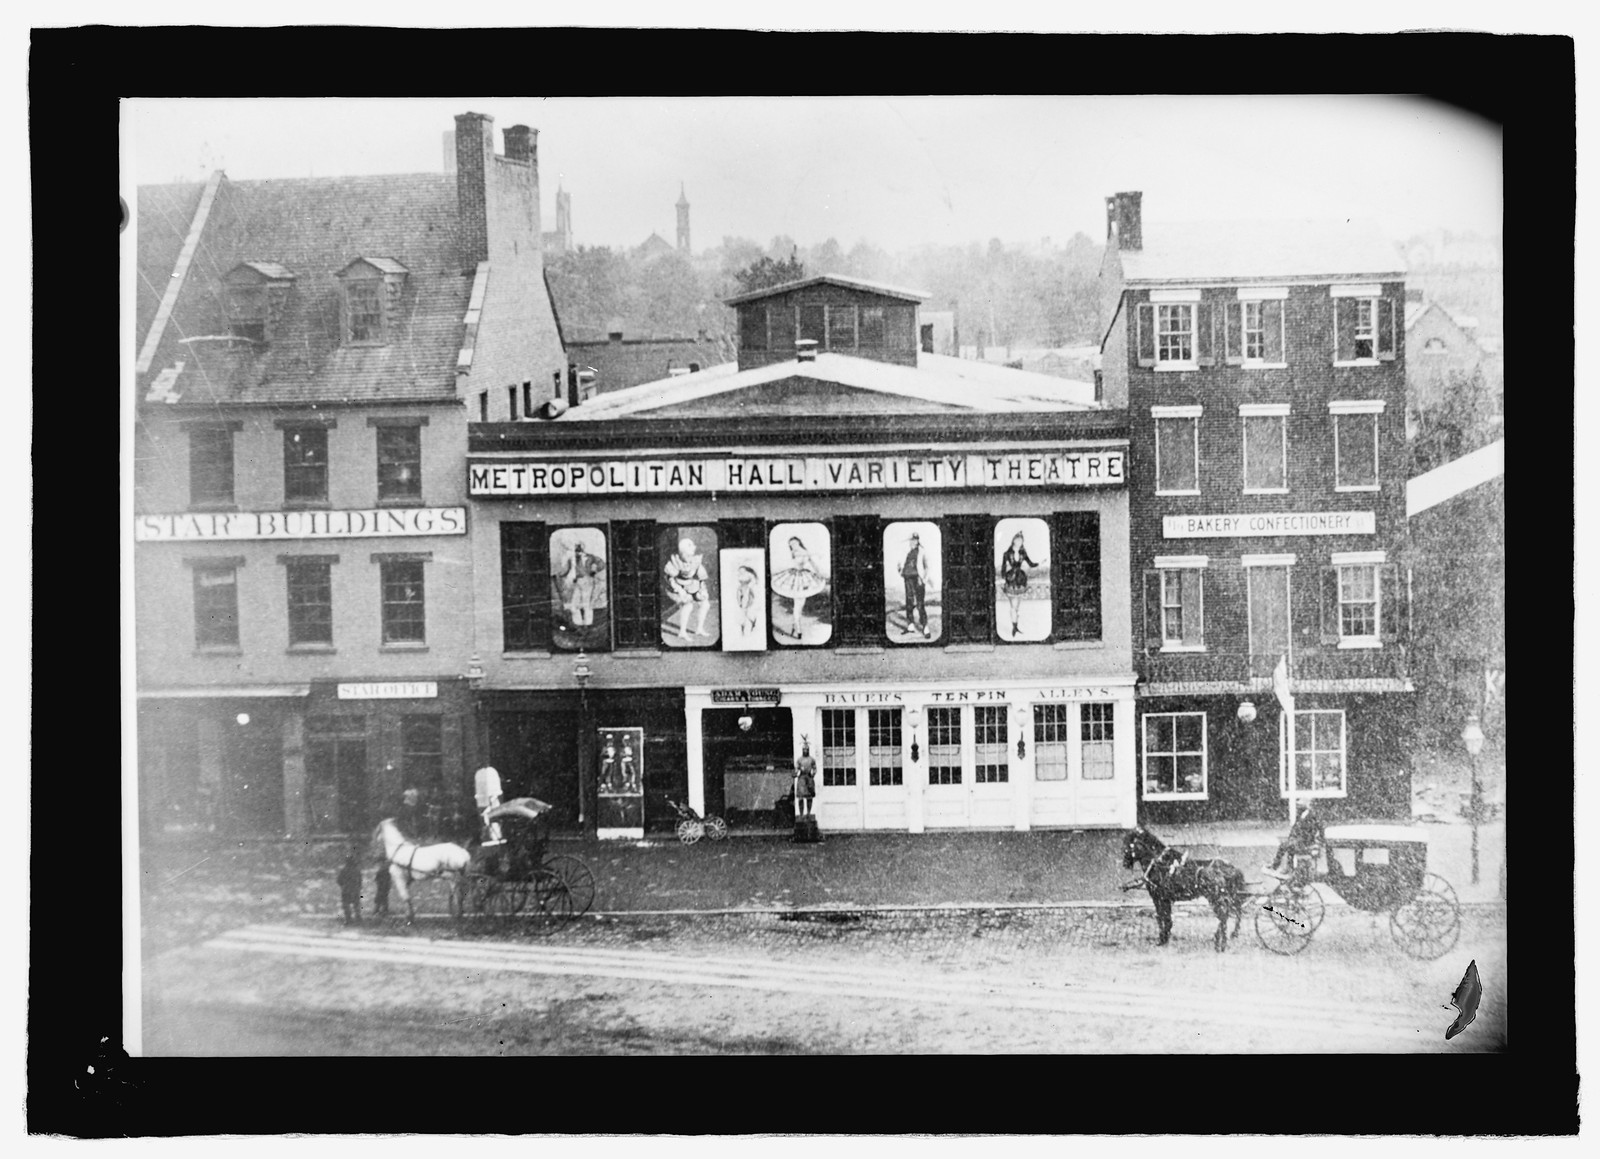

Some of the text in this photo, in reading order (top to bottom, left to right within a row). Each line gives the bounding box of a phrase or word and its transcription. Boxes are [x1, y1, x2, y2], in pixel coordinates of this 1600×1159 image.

[472, 464, 704, 488] METROPOLITAN
[828, 460, 965, 484] VARIETY
[987, 455, 1122, 481] THEATRE
[1187, 517, 1239, 532] BAKERY
[1249, 514, 1352, 531] CONFECTIONERY
[341, 684, 379, 696] STAR
[931, 692, 969, 701] TEN
[976, 691, 1006, 700] PIN
